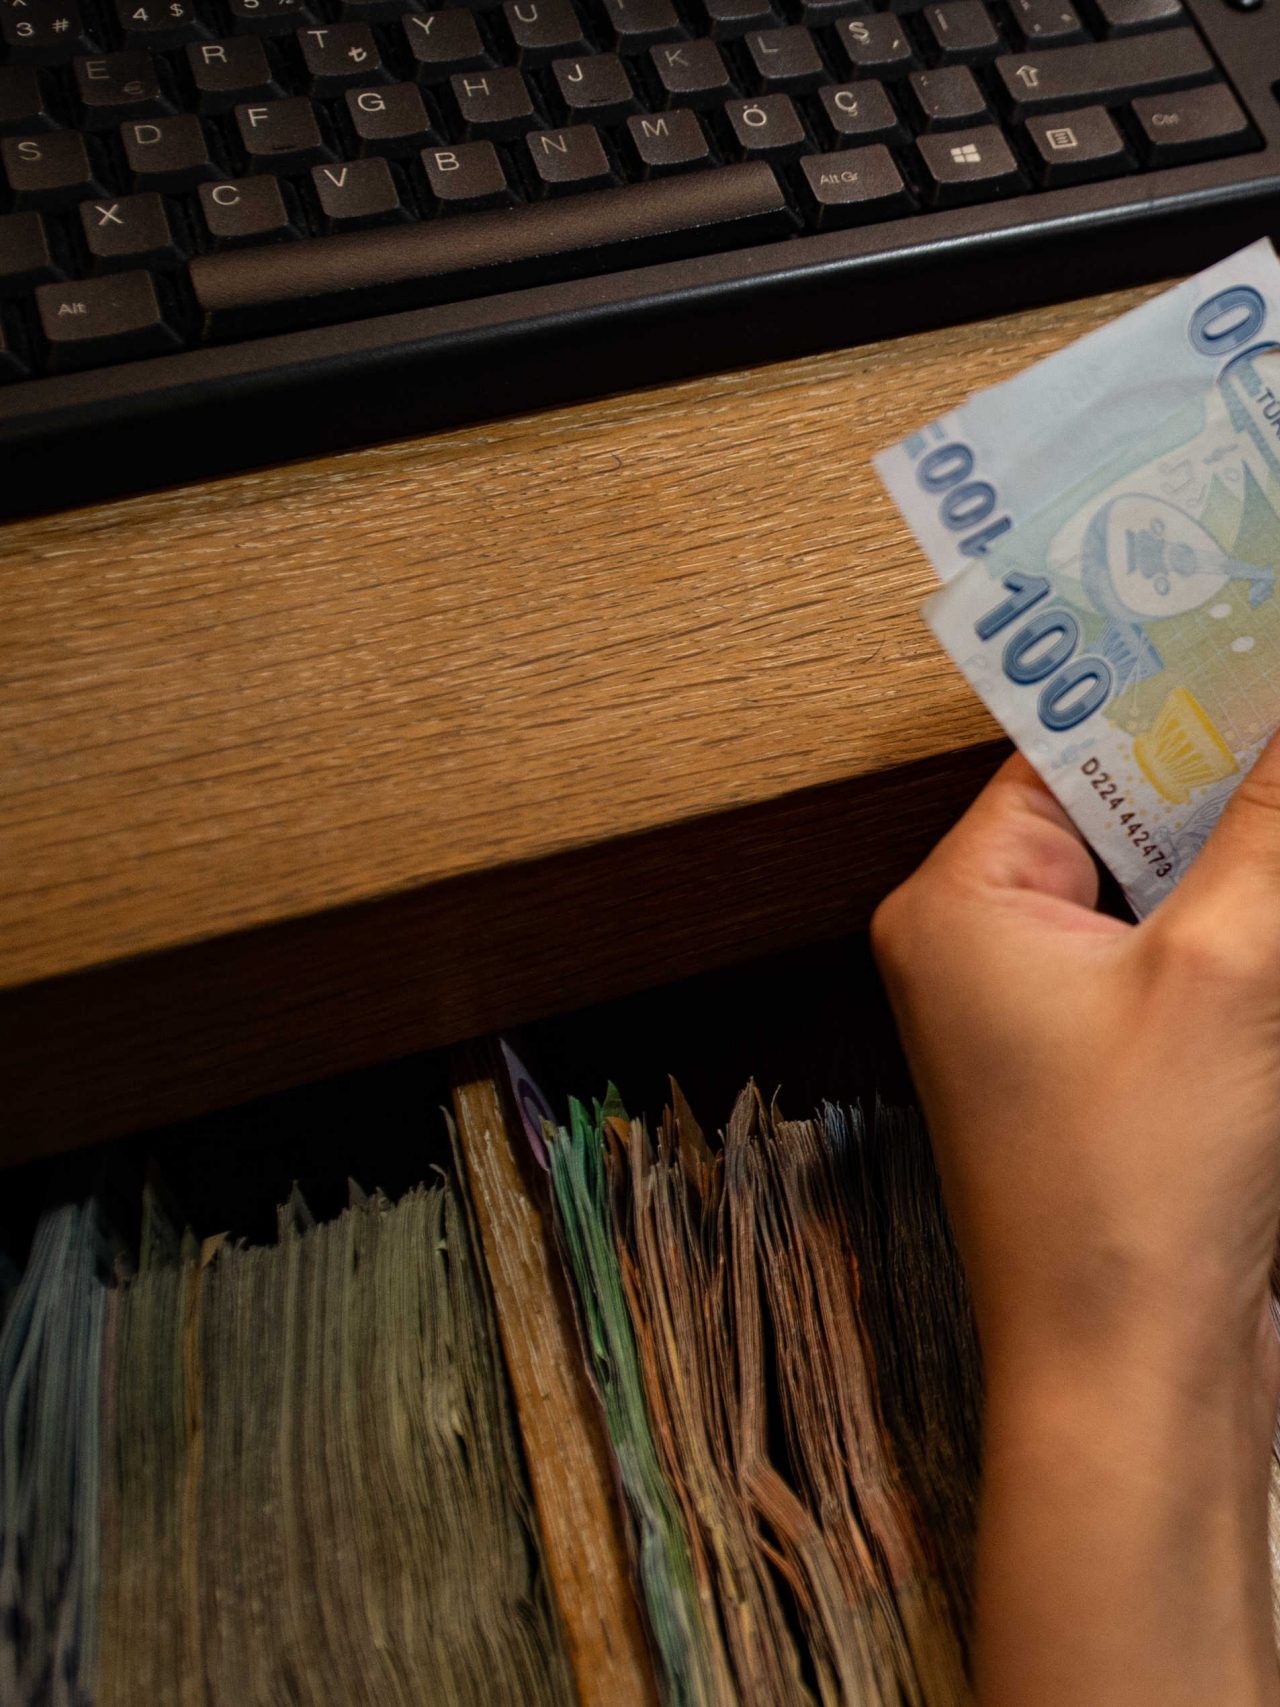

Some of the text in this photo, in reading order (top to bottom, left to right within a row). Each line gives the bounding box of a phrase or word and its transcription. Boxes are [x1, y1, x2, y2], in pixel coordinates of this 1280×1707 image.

[132, 7, 149, 21] 4
[514, 4, 538, 22] U
[16, 22, 34, 37] 3
[412, 16, 435, 35] Y
[307, 30, 328, 48] T
[758, 37, 779, 53] L
[201, 45, 228, 64] R
[664, 49, 689, 67] K
[85, 60, 110, 79] E
[568, 64, 583, 81] J
[463, 78, 490, 97] H
[357, 92, 386, 112] G
[834, 91, 857, 117] Ç
[247, 107, 268, 127] F
[743, 104, 767, 127] Ö
[133, 124, 161, 144] D
[641, 118, 669, 138] M
[18, 141, 42, 160] S
[540, 135, 567, 154] N
[434, 152, 460, 171] B
[323, 167, 348, 188] V
[212, 185, 241, 206] C
[94, 204, 124, 225] X
[57, 303, 87, 316] Alt
[916, 442, 1012, 558] 100
[975, 571, 1112, 731] 100
[1081, 757, 1172, 877] D224 442473
